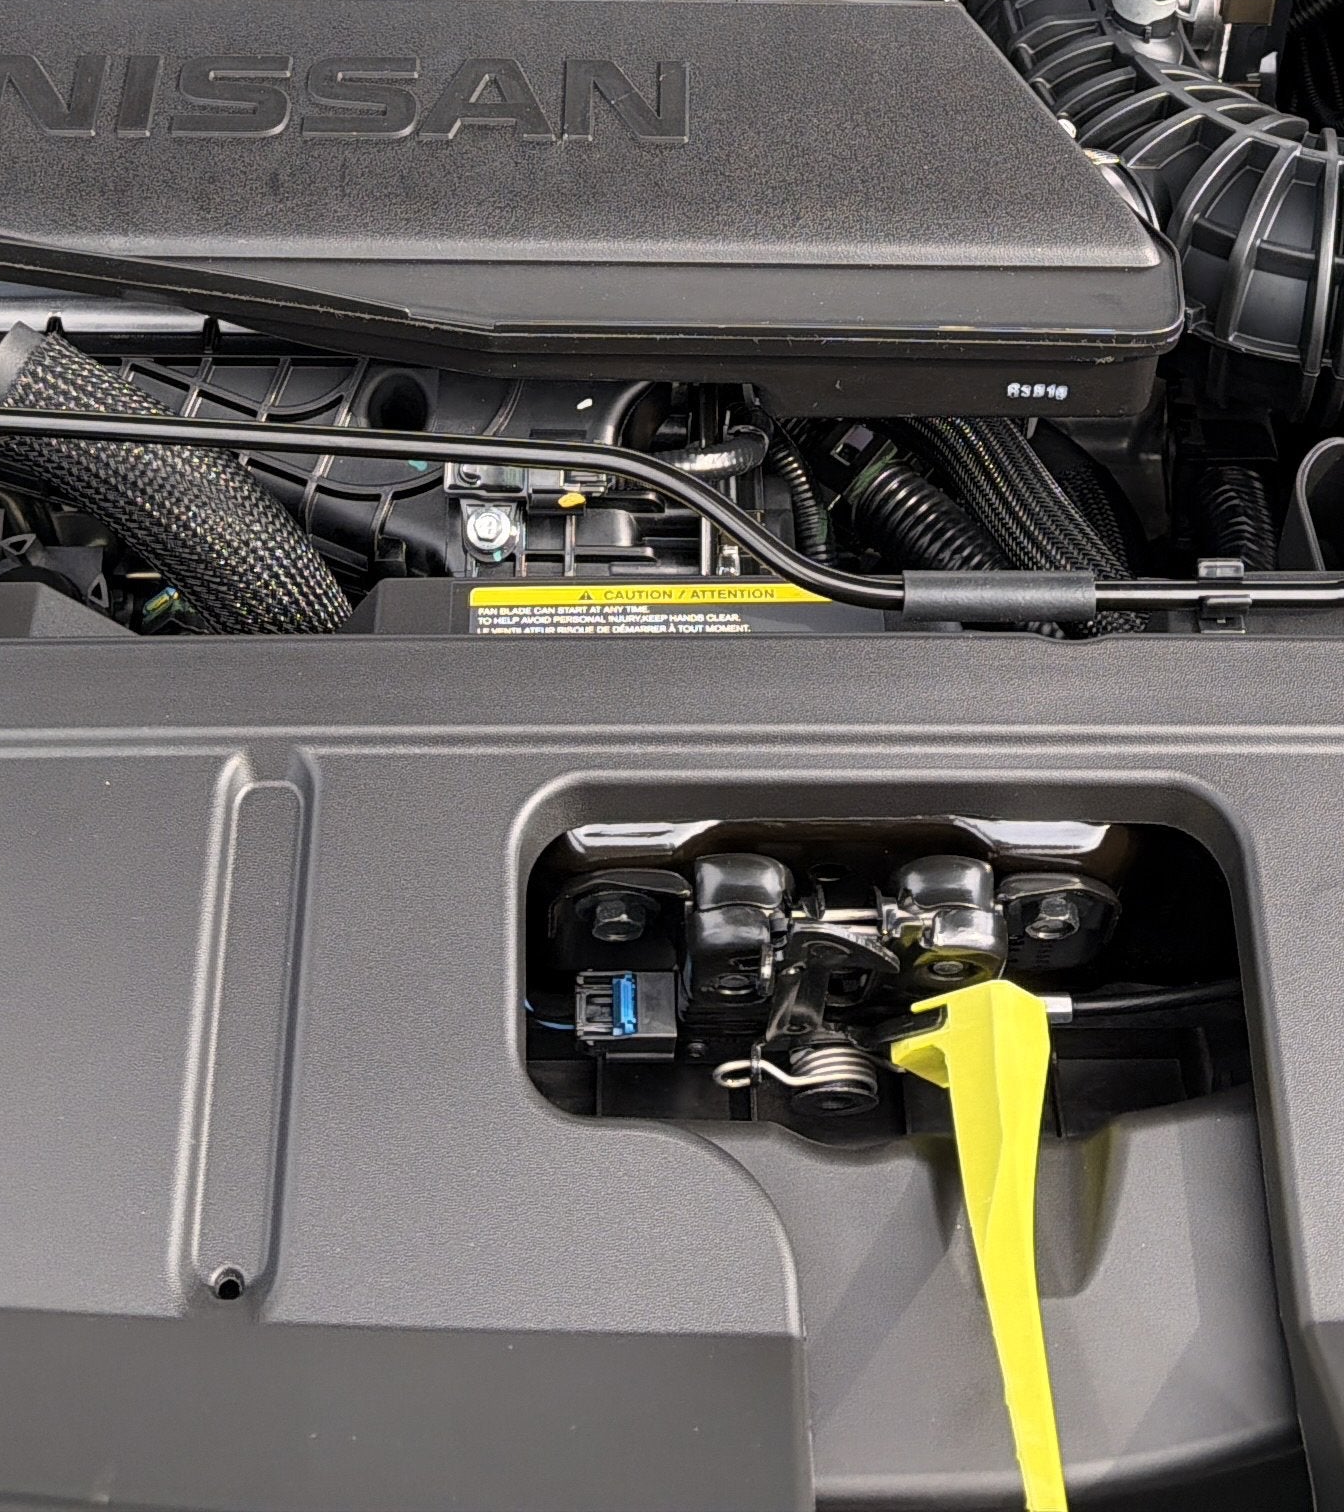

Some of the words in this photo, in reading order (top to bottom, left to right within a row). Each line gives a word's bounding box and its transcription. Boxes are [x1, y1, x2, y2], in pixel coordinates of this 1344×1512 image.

[603, 590, 673, 601] CAUTION
[677, 589, 686, 600] /
[690, 588, 775, 600] ATTENTION
[477, 607, 498, 616] FAN
[499, 607, 532, 615] BLADE
[533, 607, 555, 615] CAN
[557, 606, 587, 614] START
[589, 606, 601, 614] AT
[603, 605, 624, 614] ANY
[625, 605, 650, 614] TIME.
[477, 616, 492, 626] TO
[493, 616, 521, 625] HELP
[521, 616, 552, 624] AVOID
[552, 615, 606, 624] PERSONAL
[669, 614, 705, 623] HANDS
[706, 613, 742, 622] CLEAR.
[556, 626, 594, 634] RISQUE
[596, 625, 611, 634] DE
[678, 624, 704, 633] TOUT
[706, 624, 752, 633] MOMENT.
